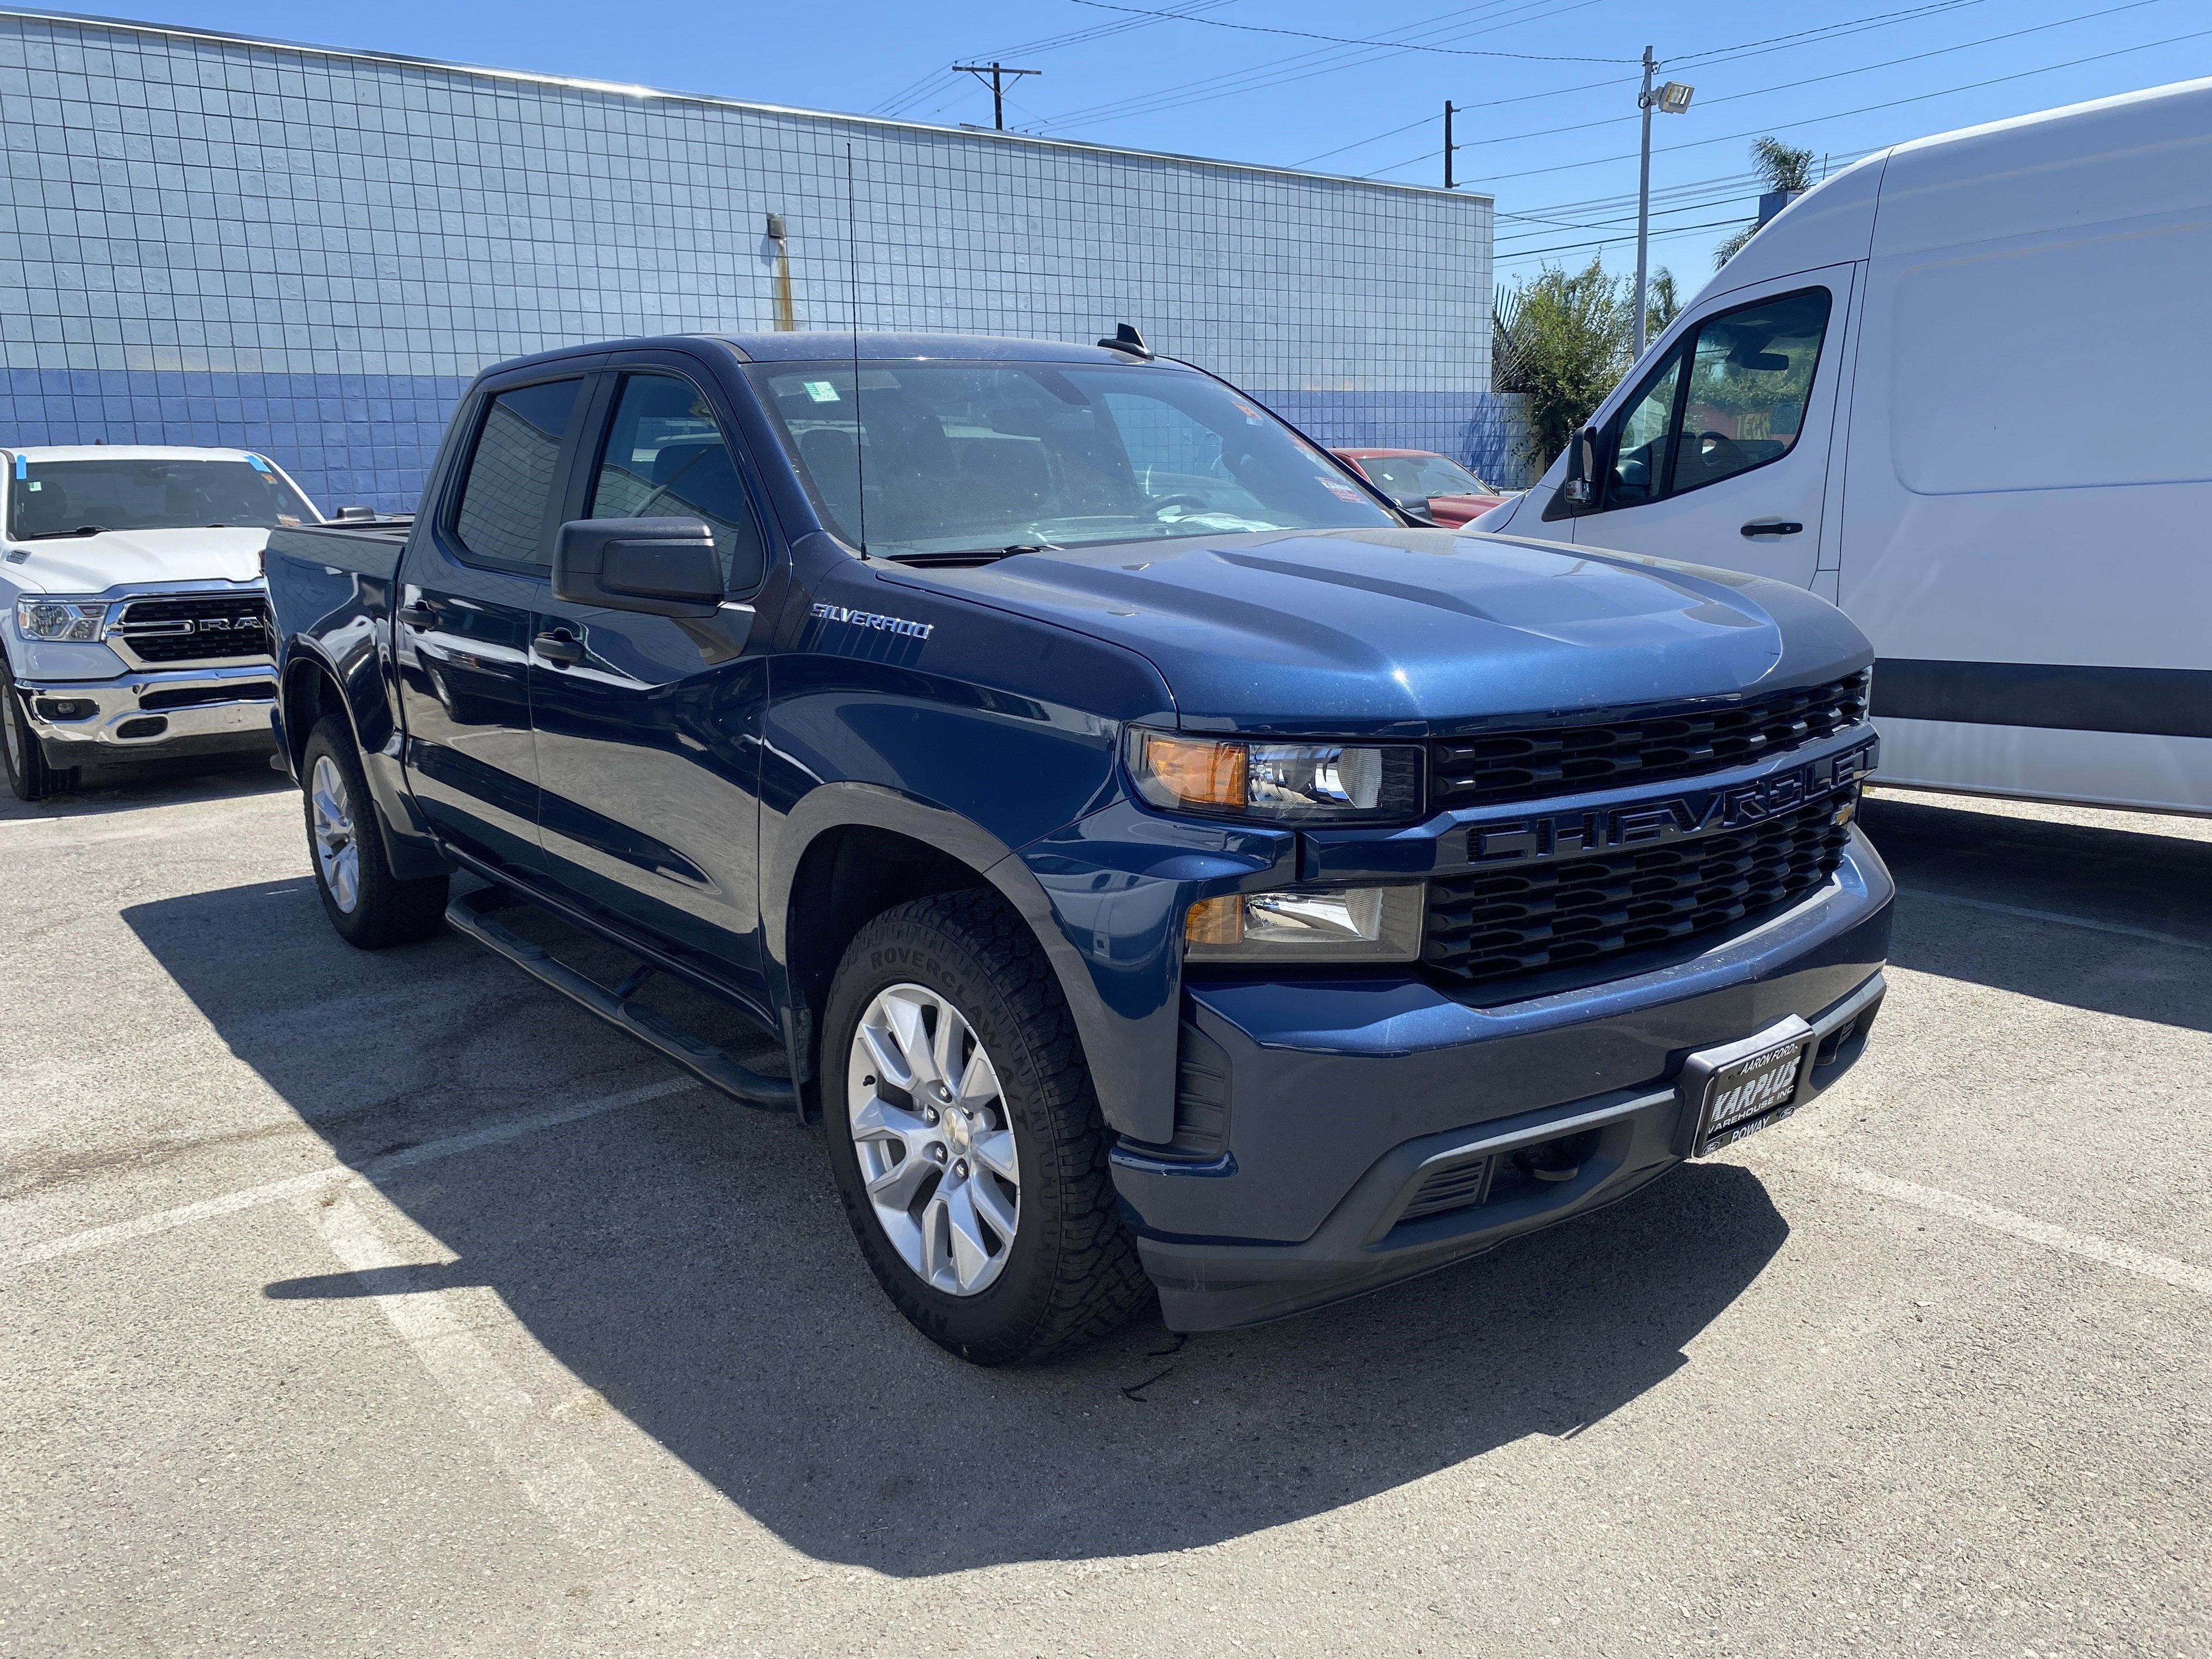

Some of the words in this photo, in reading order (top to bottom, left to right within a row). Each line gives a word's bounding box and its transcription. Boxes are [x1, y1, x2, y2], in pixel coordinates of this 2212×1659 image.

[200, 617, 264, 631] RA
[810, 602, 934, 640] SILVERADO
[1466, 744, 1877, 864] CHEVROLET
[871, 946, 1002, 1049] ROVERCLAW
[1740, 1052, 1773, 1076] AARON
[1770, 1043, 1797, 1063] FORD
[1711, 1056, 1802, 1122] KARPLUS
[1777, 1085, 1794, 1100] INC
[1731, 1115, 1770, 1143] POWAY
